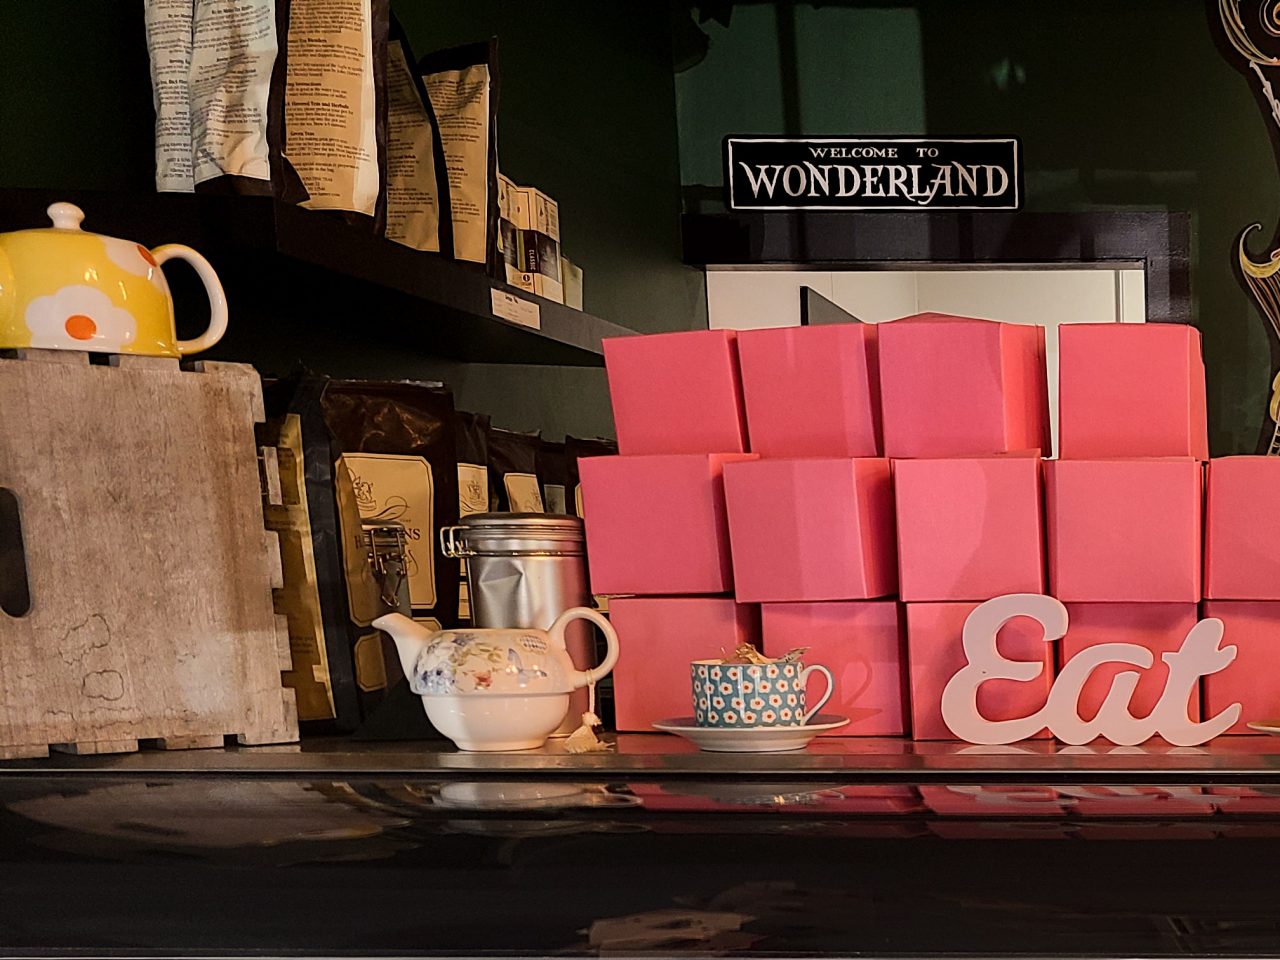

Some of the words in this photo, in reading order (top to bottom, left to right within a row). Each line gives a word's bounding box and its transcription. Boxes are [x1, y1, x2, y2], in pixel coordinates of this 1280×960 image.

[809, 147, 898, 158] WELCOME
[916, 148, 939, 158] TO
[739, 161, 1009, 205] WONDERLAND
[941, 593, 1242, 746] Eat
